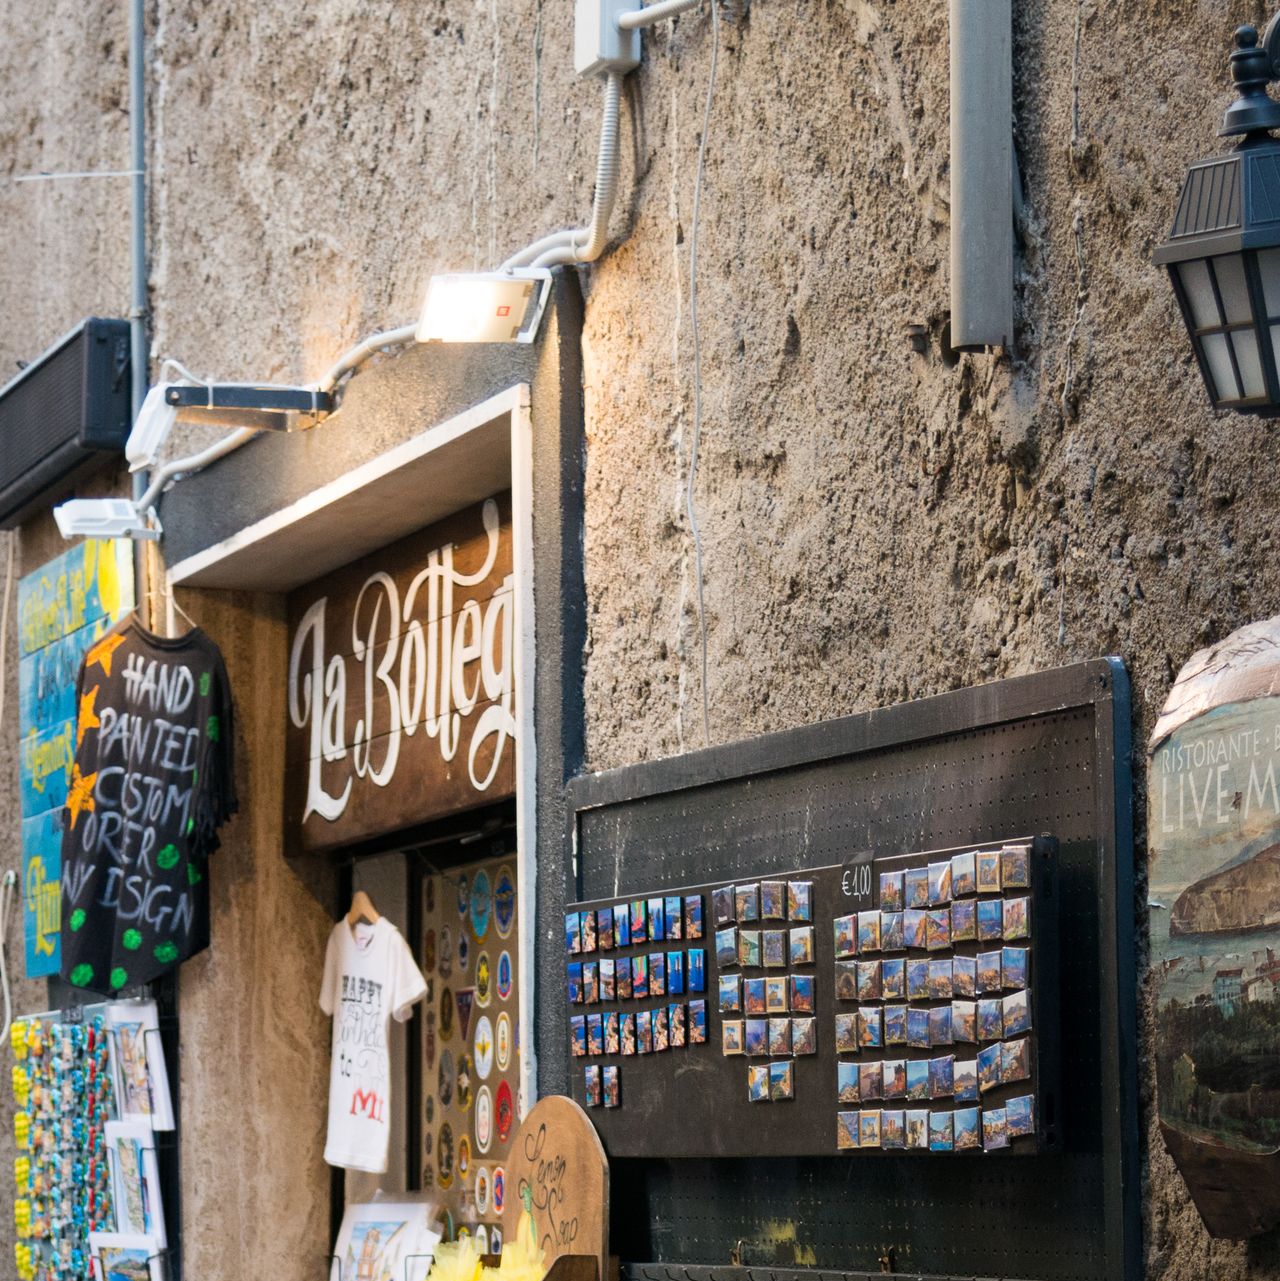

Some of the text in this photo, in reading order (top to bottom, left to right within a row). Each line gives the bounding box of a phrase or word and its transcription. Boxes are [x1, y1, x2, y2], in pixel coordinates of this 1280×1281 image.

[122, 652, 195, 715] HAND
[289, 499, 516, 824] La Botteg
[1162, 729, 1260, 775] RISTORANTE
[1162, 763, 1230, 833] LIVE
[841, 865, 871, 902] €1,00
[341, 974, 383, 1008] HAPPY
[518, 1122, 566, 1210] Lemon
